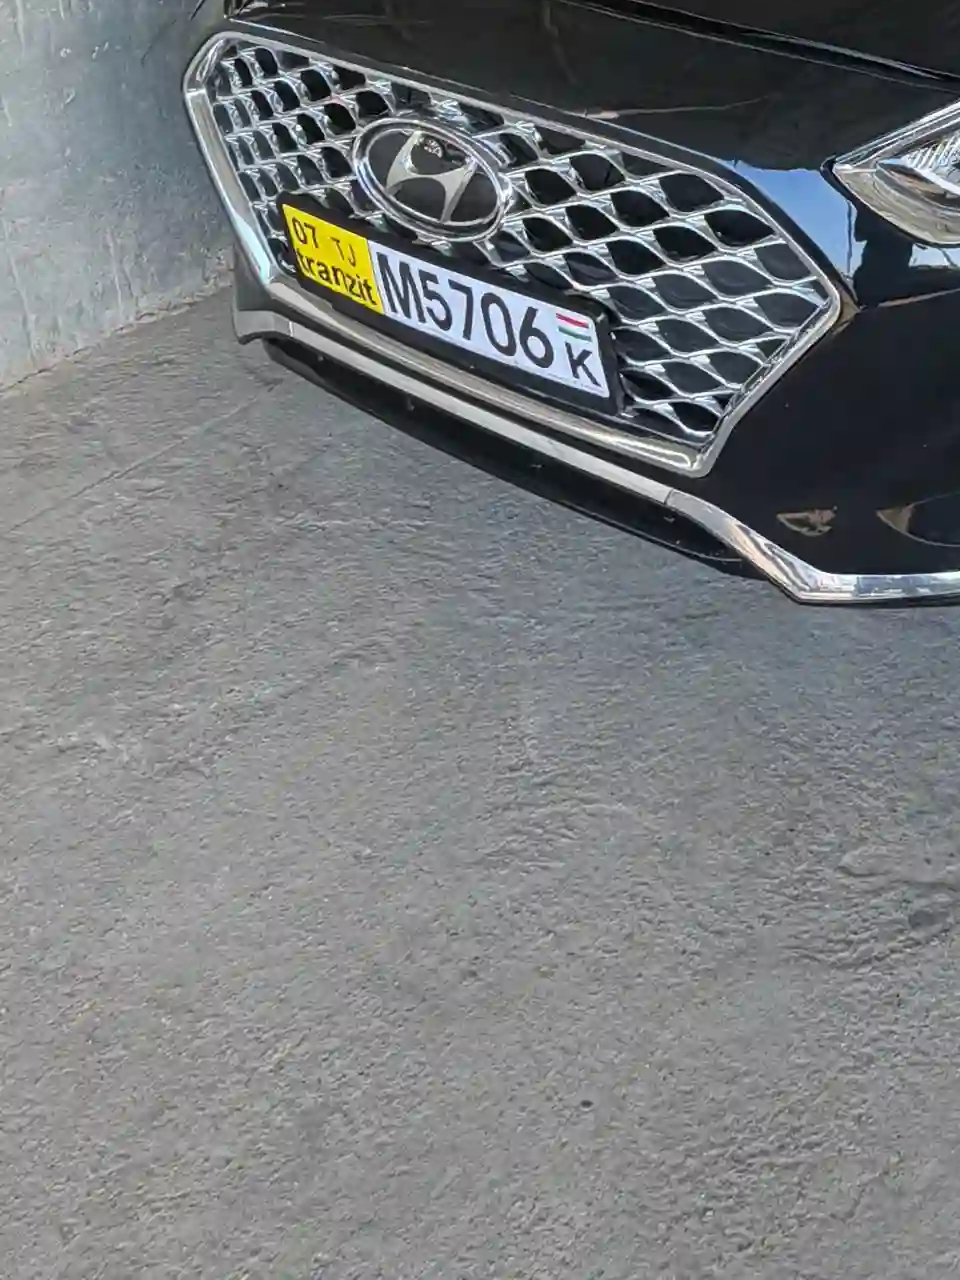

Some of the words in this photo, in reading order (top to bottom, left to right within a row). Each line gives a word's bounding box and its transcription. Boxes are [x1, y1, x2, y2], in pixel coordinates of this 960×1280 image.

[292, 217, 319, 248] 07
[330, 236, 356, 268] TJ
[297, 248, 377, 305] tranzit
[376, 251, 554, 369] M5706
[565, 342, 601, 387] K
